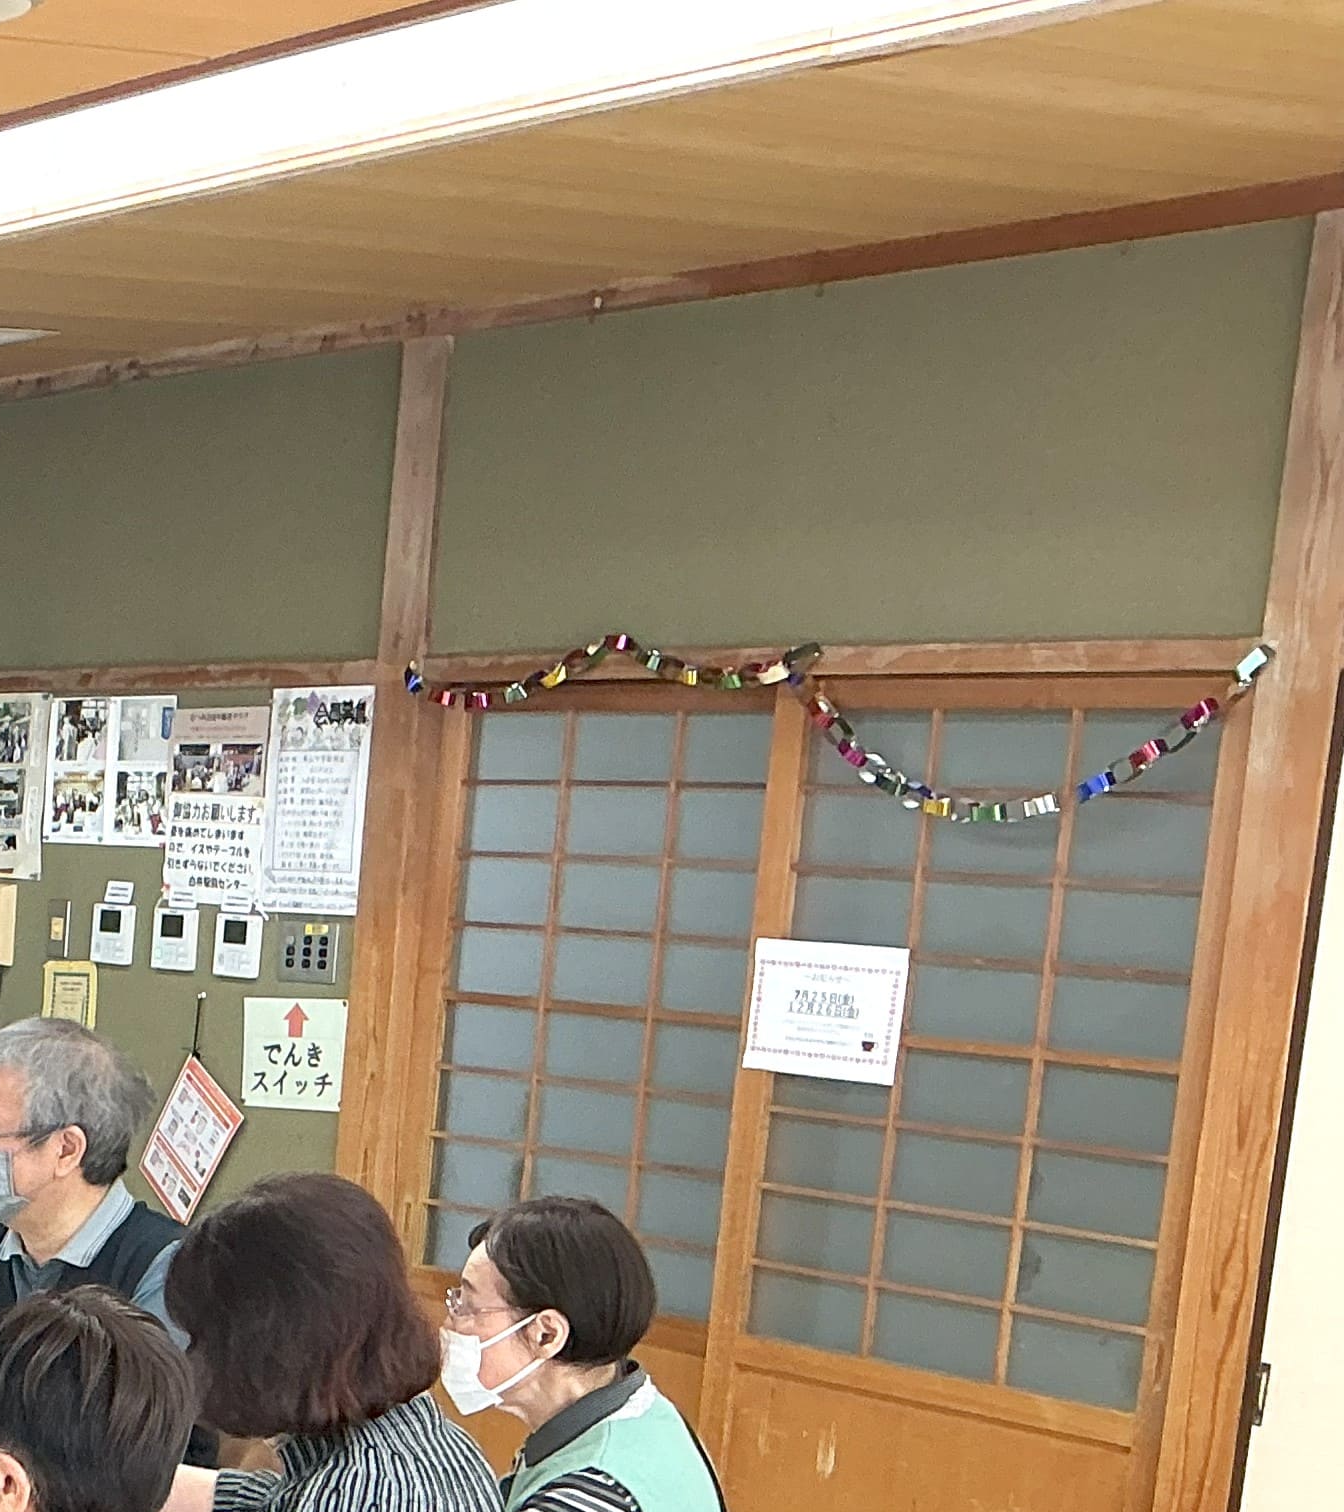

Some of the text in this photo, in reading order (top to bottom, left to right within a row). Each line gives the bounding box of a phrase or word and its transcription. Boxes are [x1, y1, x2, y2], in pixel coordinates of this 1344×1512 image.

[173, 801, 261, 825] 御協力お願いします。
[263, 1041, 323, 1068] でんき
[251, 1070, 333, 1097] スイッチ
